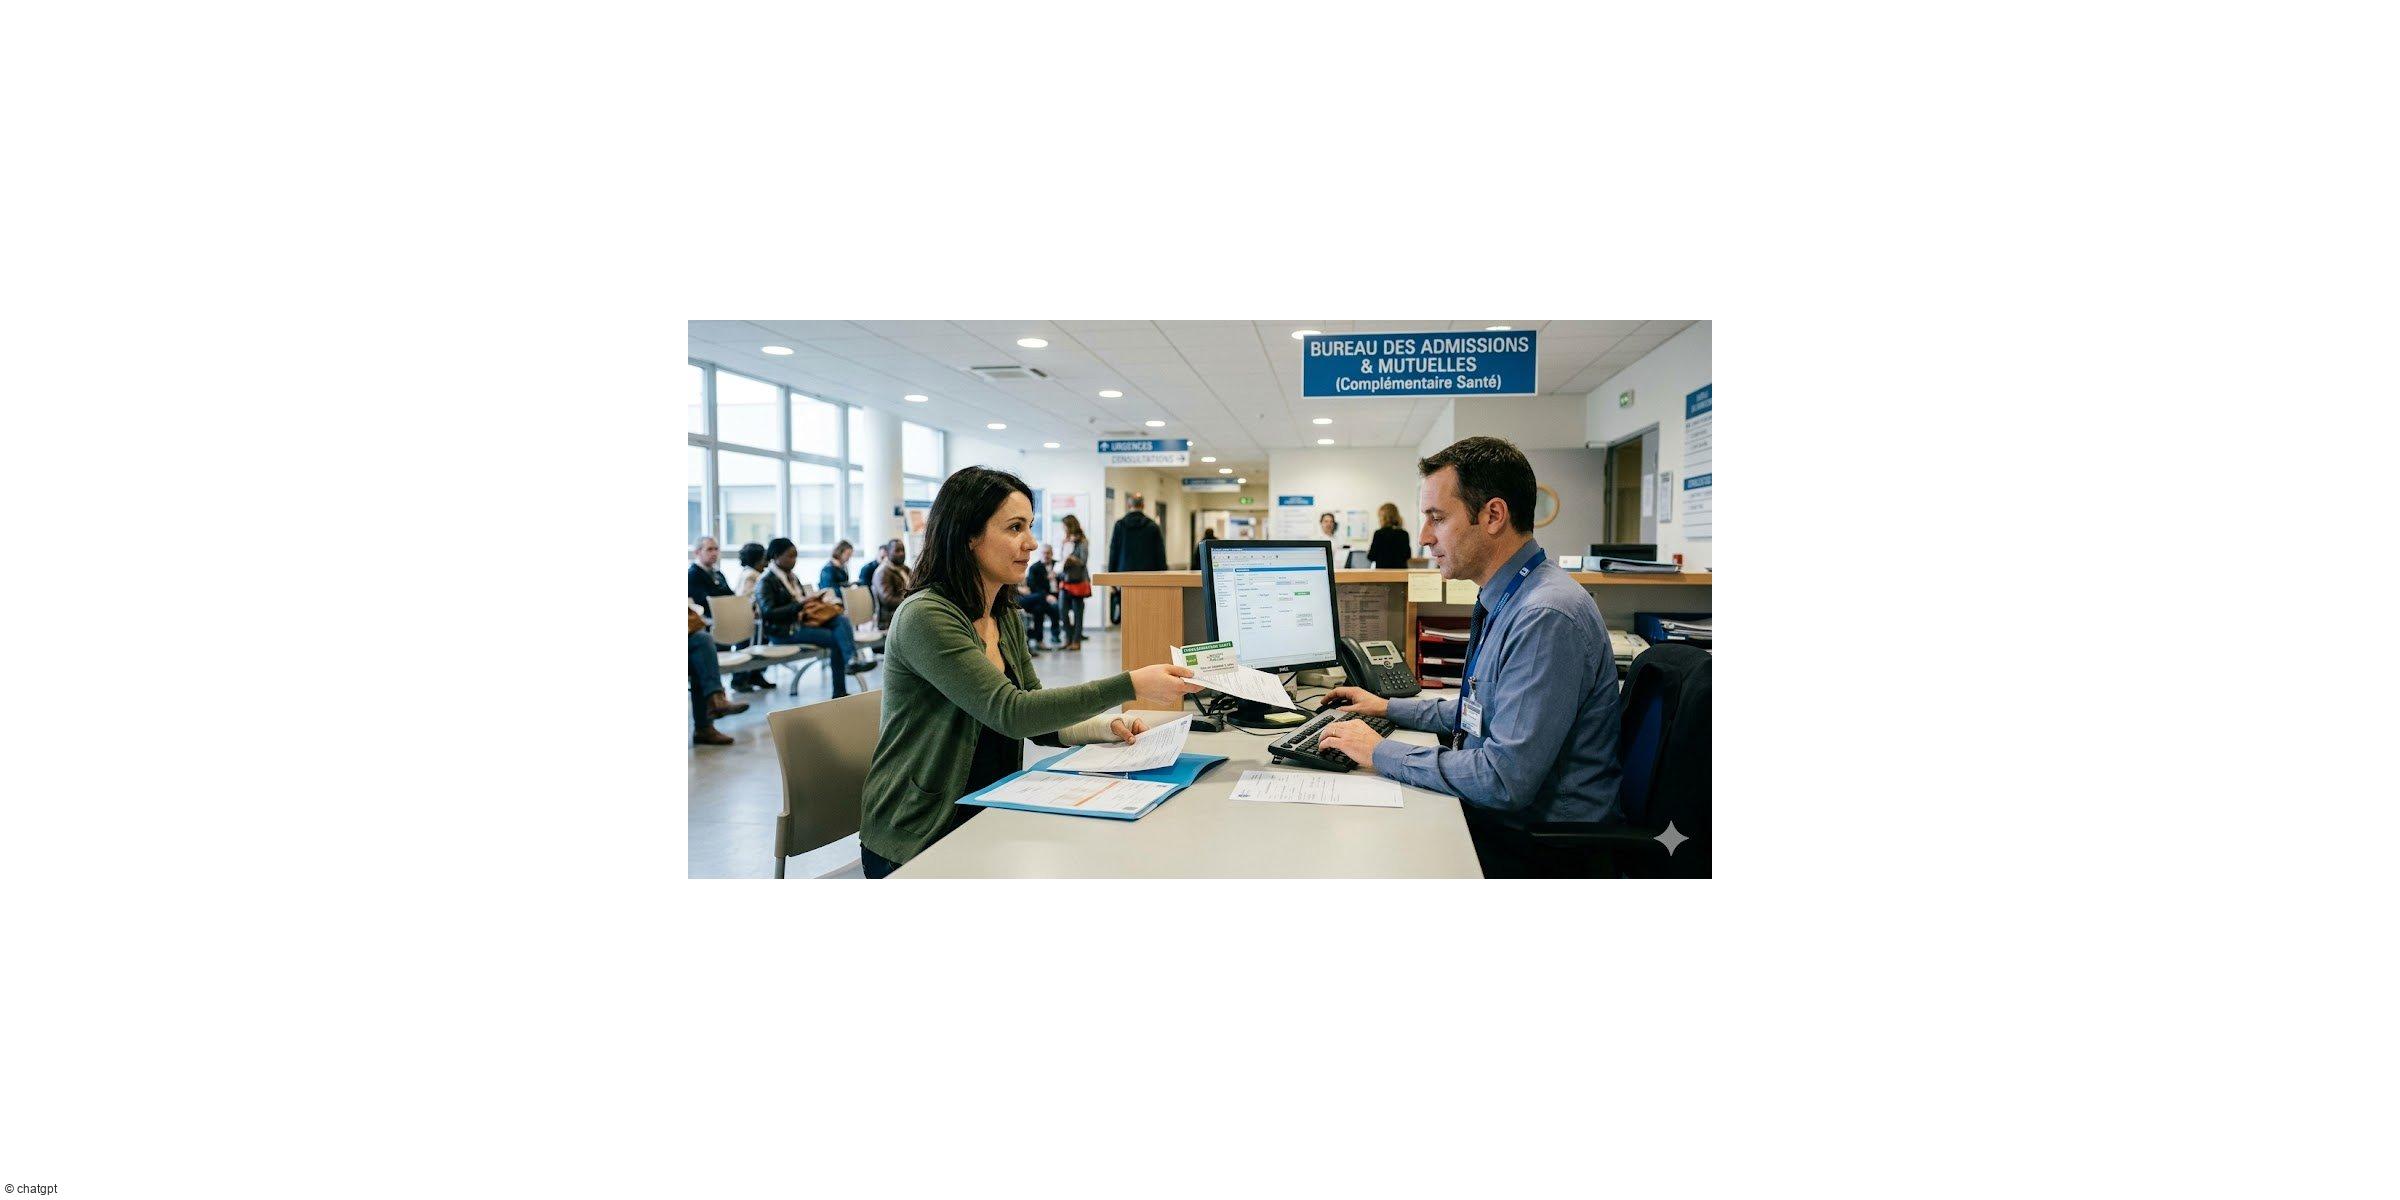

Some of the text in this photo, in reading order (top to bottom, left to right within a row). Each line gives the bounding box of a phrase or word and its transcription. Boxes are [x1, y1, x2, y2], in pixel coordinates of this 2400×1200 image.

[1310, 337, 1529, 357] BUREAU DES ADMISSIONS
[1360, 357, 1477, 374] & MUTUELLES
[1335, 373, 1502, 393] (Complémentaire Santé)
[1111, 441, 1153, 451] URGENCES
[1112, 454, 1174, 464] CONSULTATIONS
